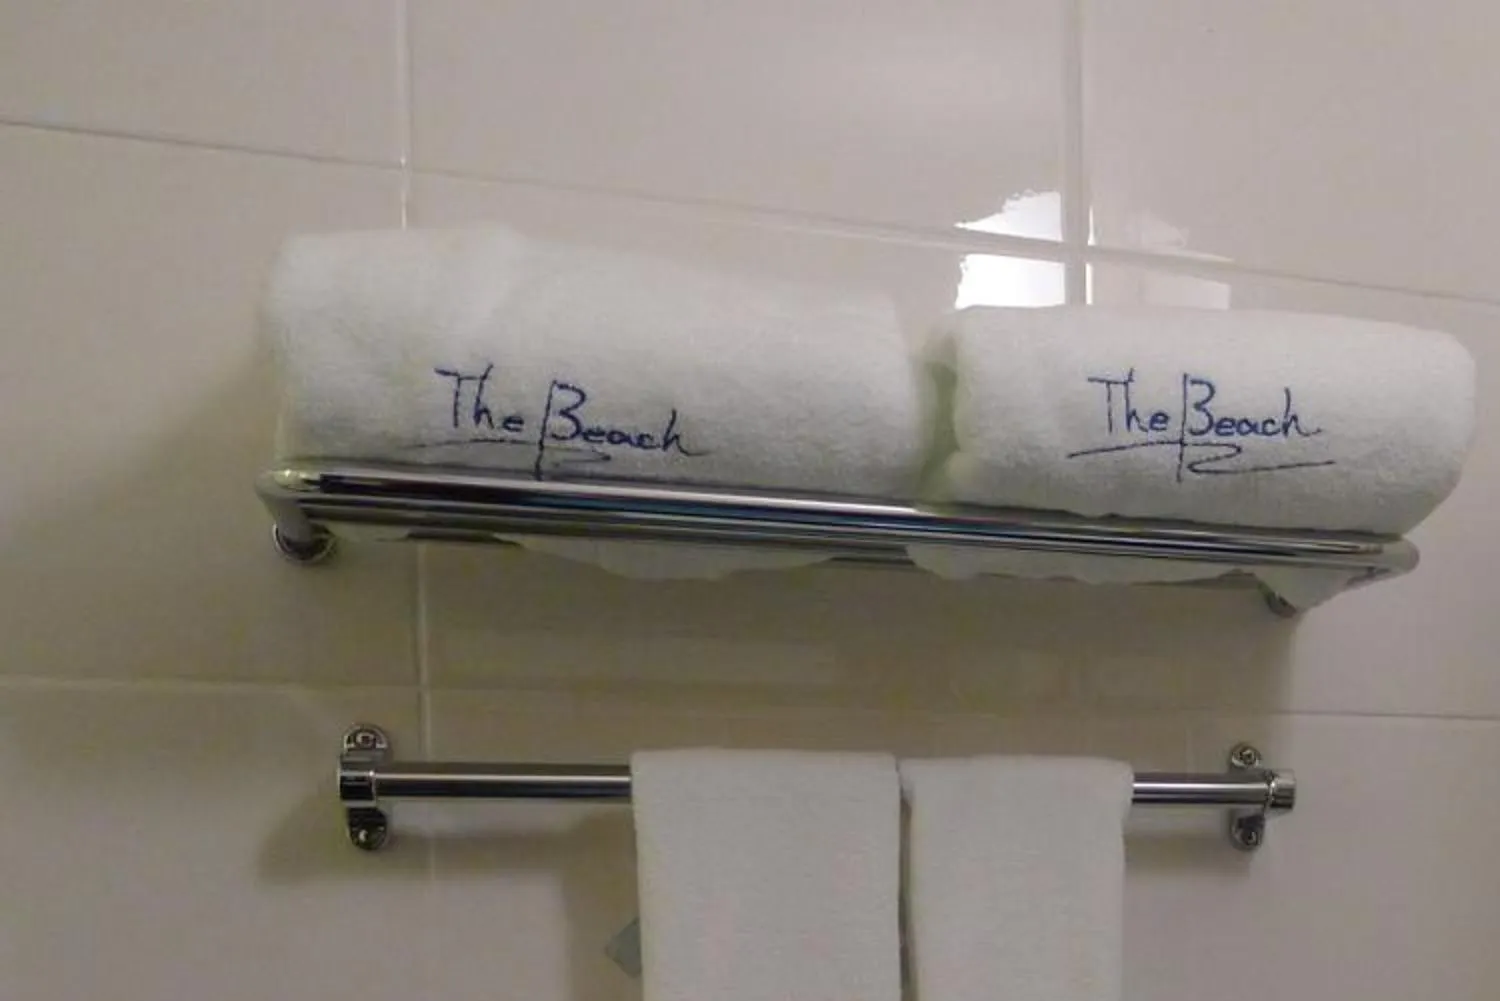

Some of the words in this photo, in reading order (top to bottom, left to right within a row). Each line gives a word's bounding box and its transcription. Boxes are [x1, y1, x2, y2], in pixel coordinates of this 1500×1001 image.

[433, 362, 525, 431] The
[534, 378, 708, 481] Beach
[1087, 367, 1171, 433] The
[1174, 372, 1323, 483] Beach
